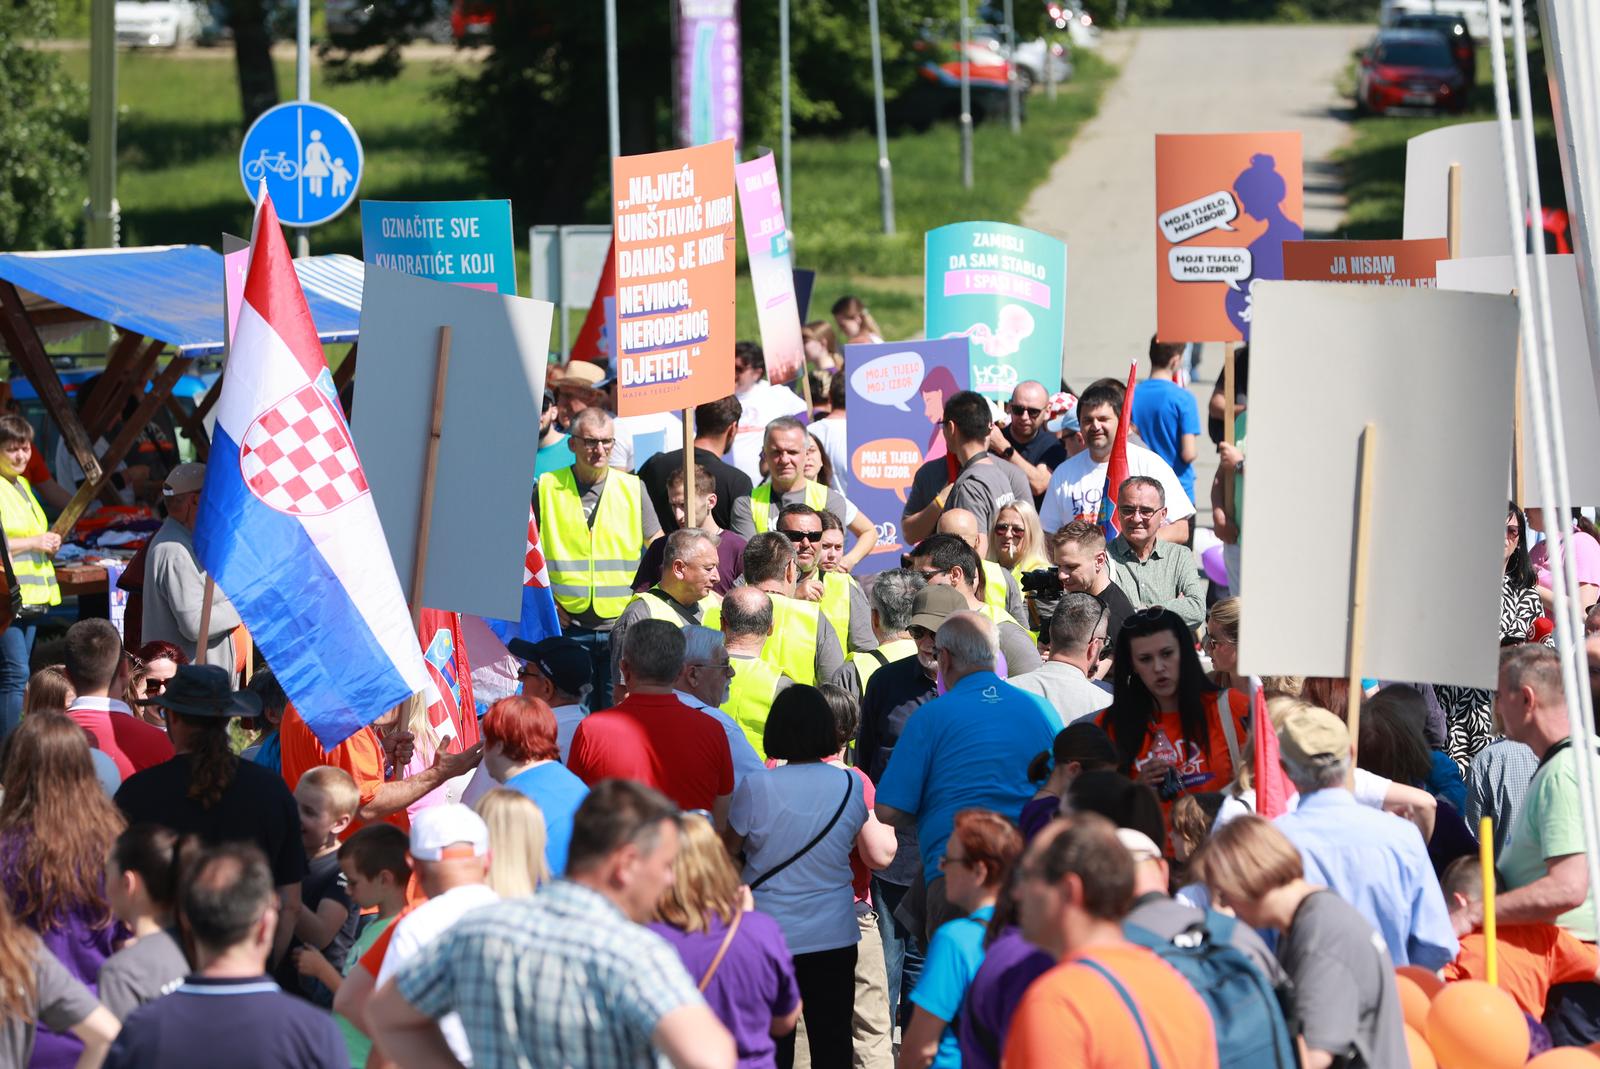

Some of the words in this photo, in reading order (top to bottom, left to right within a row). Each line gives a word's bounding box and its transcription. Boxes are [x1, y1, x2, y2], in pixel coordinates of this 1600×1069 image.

[618, 196, 703, 242] UNIŠTAVAČ
[705, 195, 733, 229] MIRA
[1164, 212, 1191, 227] MOJE
[1192, 198, 1229, 216] TIJELO,
[1174, 221, 1195, 234] MOJ
[1196, 208, 1226, 226] IZBOR!
[382, 214, 445, 238] OZNAČITE
[451, 217, 480, 238] SVE
[973, 233, 1024, 253] ZAMISLI
[461, 253, 495, 274] KOJI
[619, 245, 675, 278] DANAS
[679, 240, 696, 270] JE
[699, 233, 725, 266] KRIK
[1176, 255, 1204, 263] MOJE
[1206, 255, 1245, 264] TIJELO,
[1330, 256, 1348, 274] JA
[1350, 255, 1396, 274] NISAM
[949, 254, 967, 270] DA
[970, 253, 999, 268] SAM
[1001, 256, 1046, 280] STABLO
[620, 279, 692, 314] NEVINOG,
[864, 367, 889, 379] MOJE
[892, 362, 920, 376] TIJELO
[867, 383, 885, 393] MOJ
[889, 377, 913, 390] IZBOR
[861, 450, 887, 464] MOJE
[890, 451, 919, 464] TIJELO
[861, 465, 882, 479] MOJ
[884, 465, 910, 479] IZBOR
